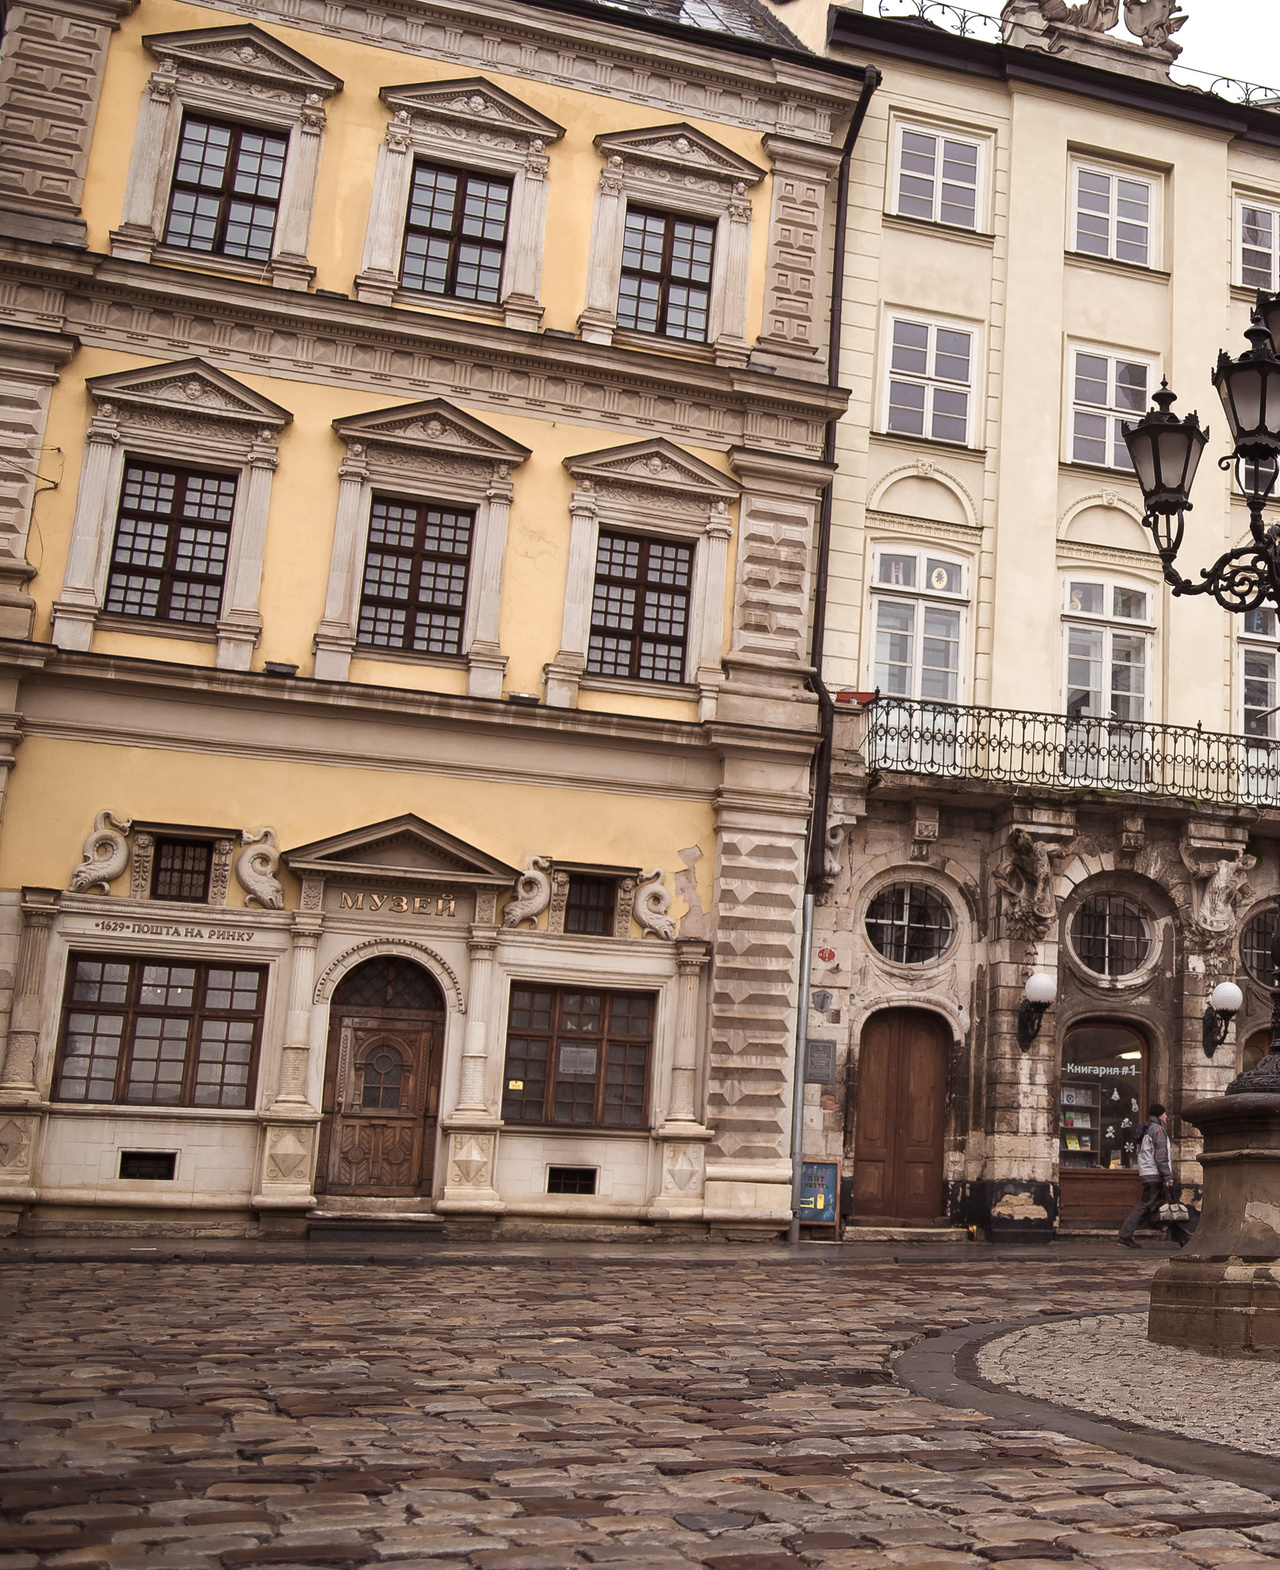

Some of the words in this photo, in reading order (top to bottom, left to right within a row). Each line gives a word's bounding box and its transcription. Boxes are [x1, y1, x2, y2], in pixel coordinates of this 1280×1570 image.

[339, 891, 457, 917] МУЗЕЙ
[132, 923, 181, 936] ПОШТА
[184, 928, 204, 938] НА
[208, 929, 254, 941] РИНКУ
[1067, 1063, 1119, 1077] Книгарня
[1121, 1064, 1136, 1076] #1
[807, 1175, 825, 1183] ART
